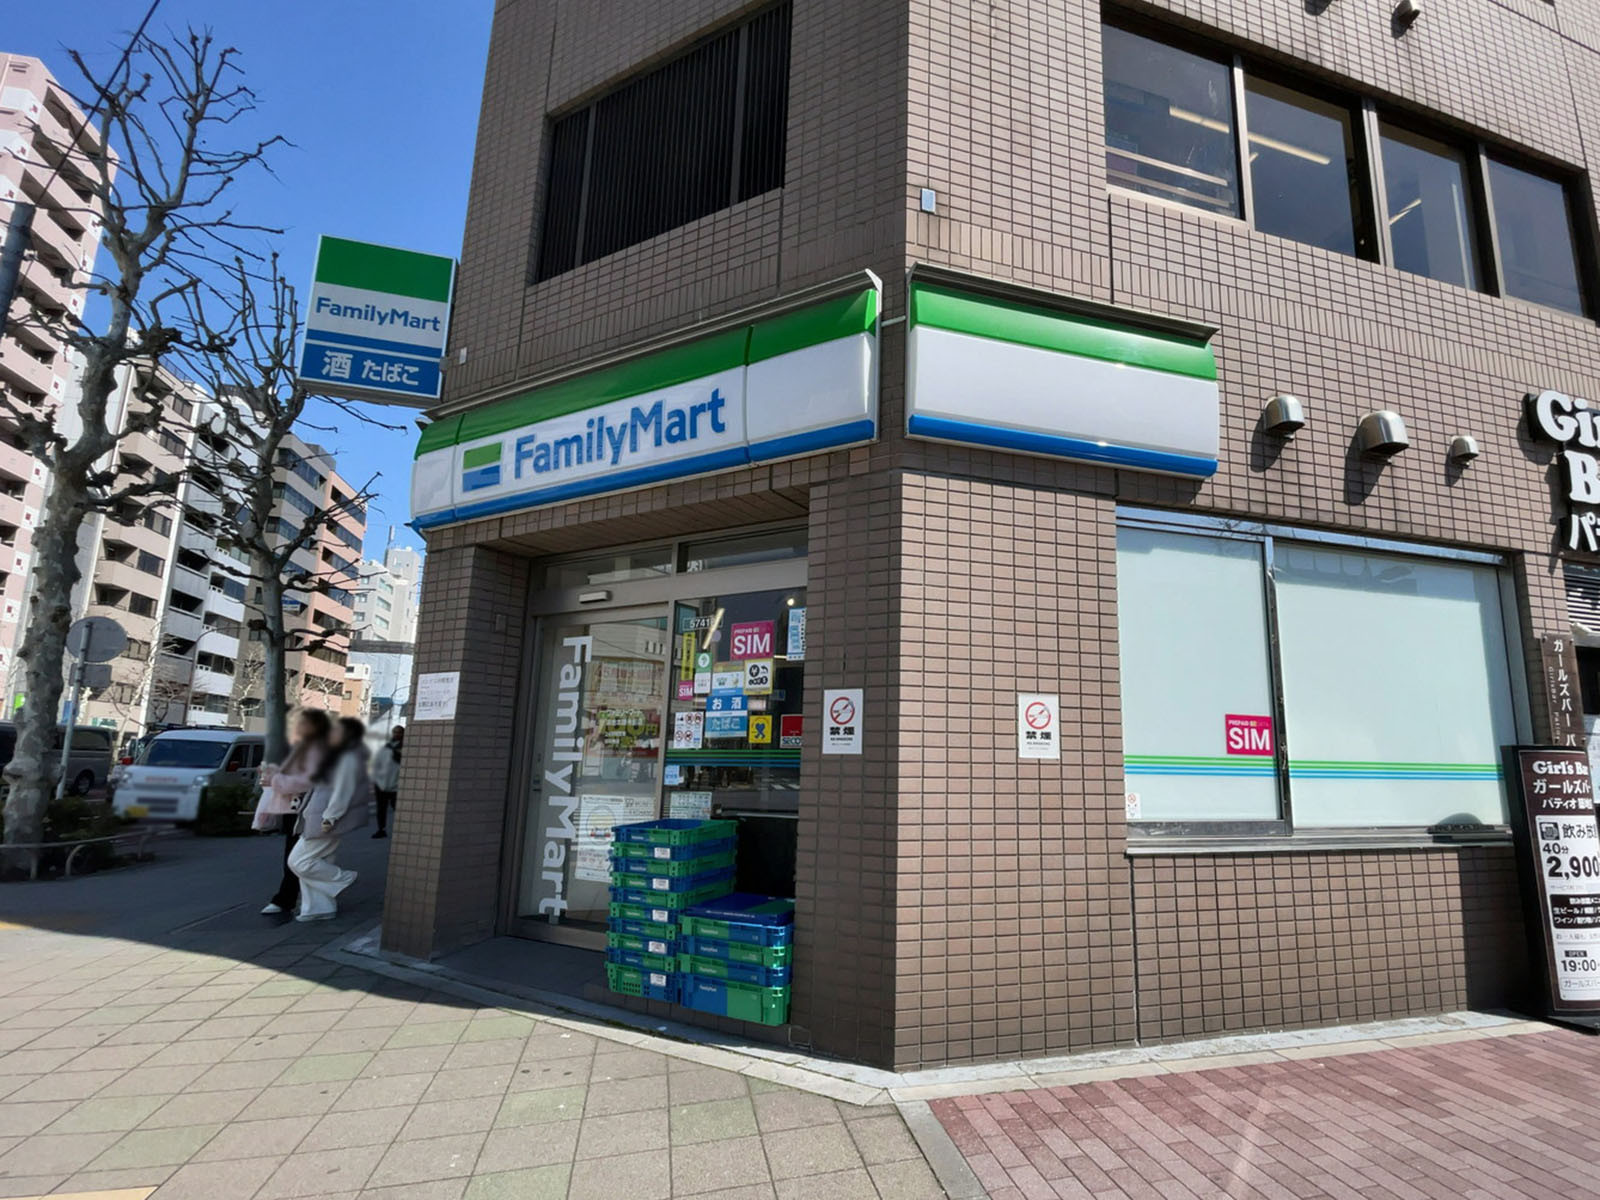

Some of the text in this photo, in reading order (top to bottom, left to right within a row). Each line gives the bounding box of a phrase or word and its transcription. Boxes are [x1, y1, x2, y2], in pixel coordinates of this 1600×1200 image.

[316, 296, 441, 332] FamilyMart
[321, 350, 420, 386] 酒 たばこ
[514, 387, 726, 480] FamilyMart
[733, 633, 771, 655] SIM
[678, 686, 693, 697] SIM
[1553, 639, 1573, 727] ガールズバー
[830, 726, 855, 735] 禁煙
[1026, 731, 1052, 740] 禁煙
[1229, 727, 1271, 751] SIM
[538, 636, 593, 917] FamilyMart
[1532, 760, 1574, 775] Girl's
